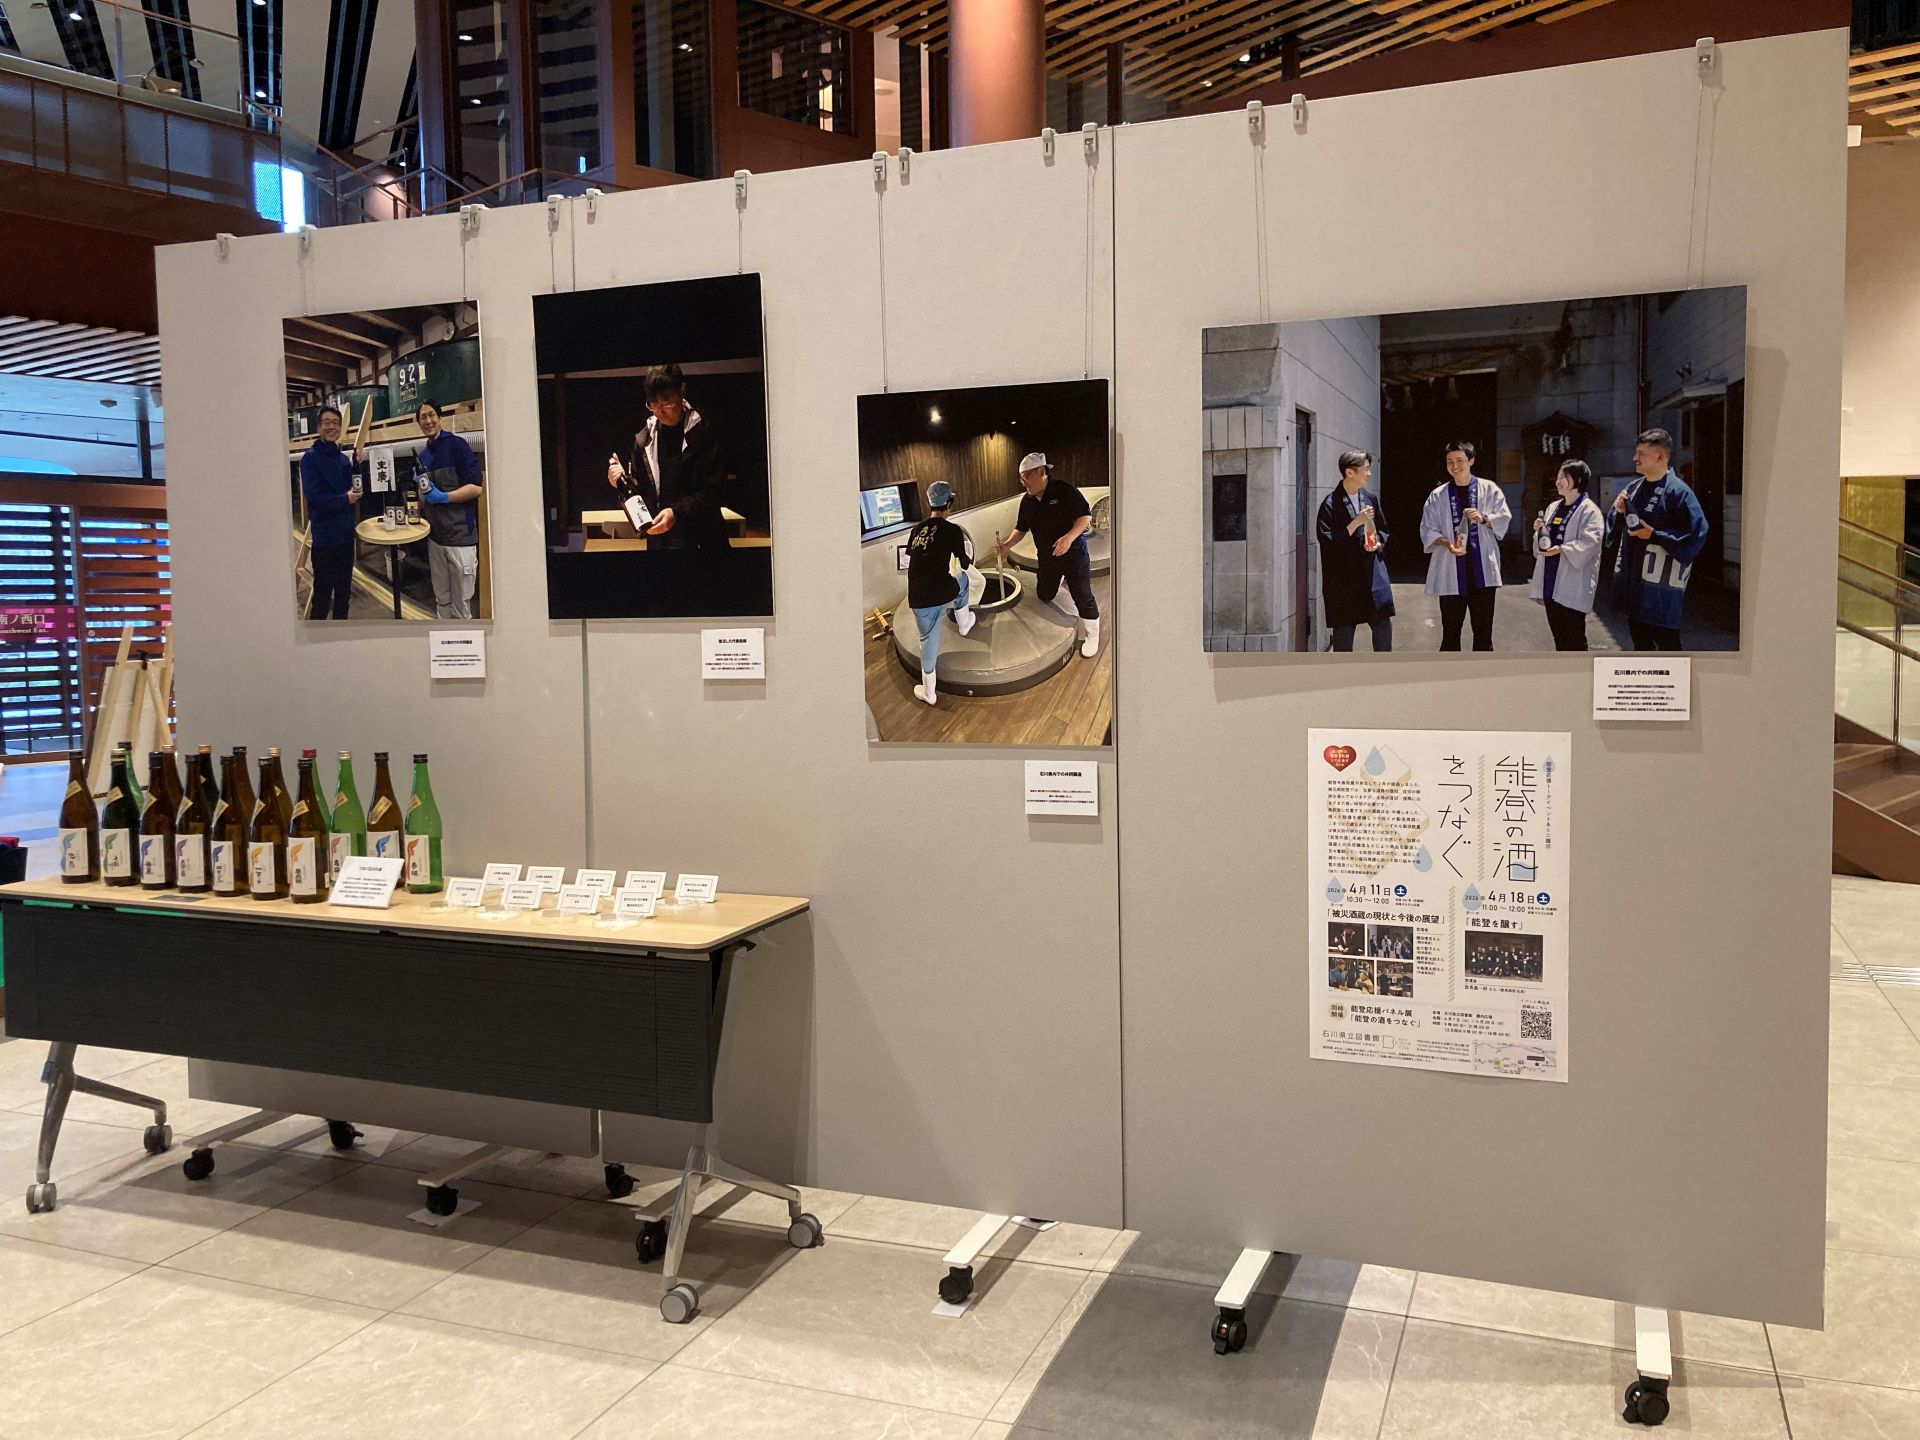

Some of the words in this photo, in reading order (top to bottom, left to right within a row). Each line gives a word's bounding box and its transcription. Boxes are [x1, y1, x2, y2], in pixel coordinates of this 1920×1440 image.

[1437, 754, 1472, 878] をつなぐ
[1492, 754, 1539, 882] 能登の酒
[1328, 909, 1445, 924] 「被災酒蔵の現状と今後の展望」
[1466, 918, 1523, 930] 「能登を醸す」
[1350, 1004, 1413, 1018] 能登応援パネル展
[1350, 1014, 1421, 1028] 「能登の酒をつなぐ」
[1322, 1030, 1380, 1042] 石川県立図書館
